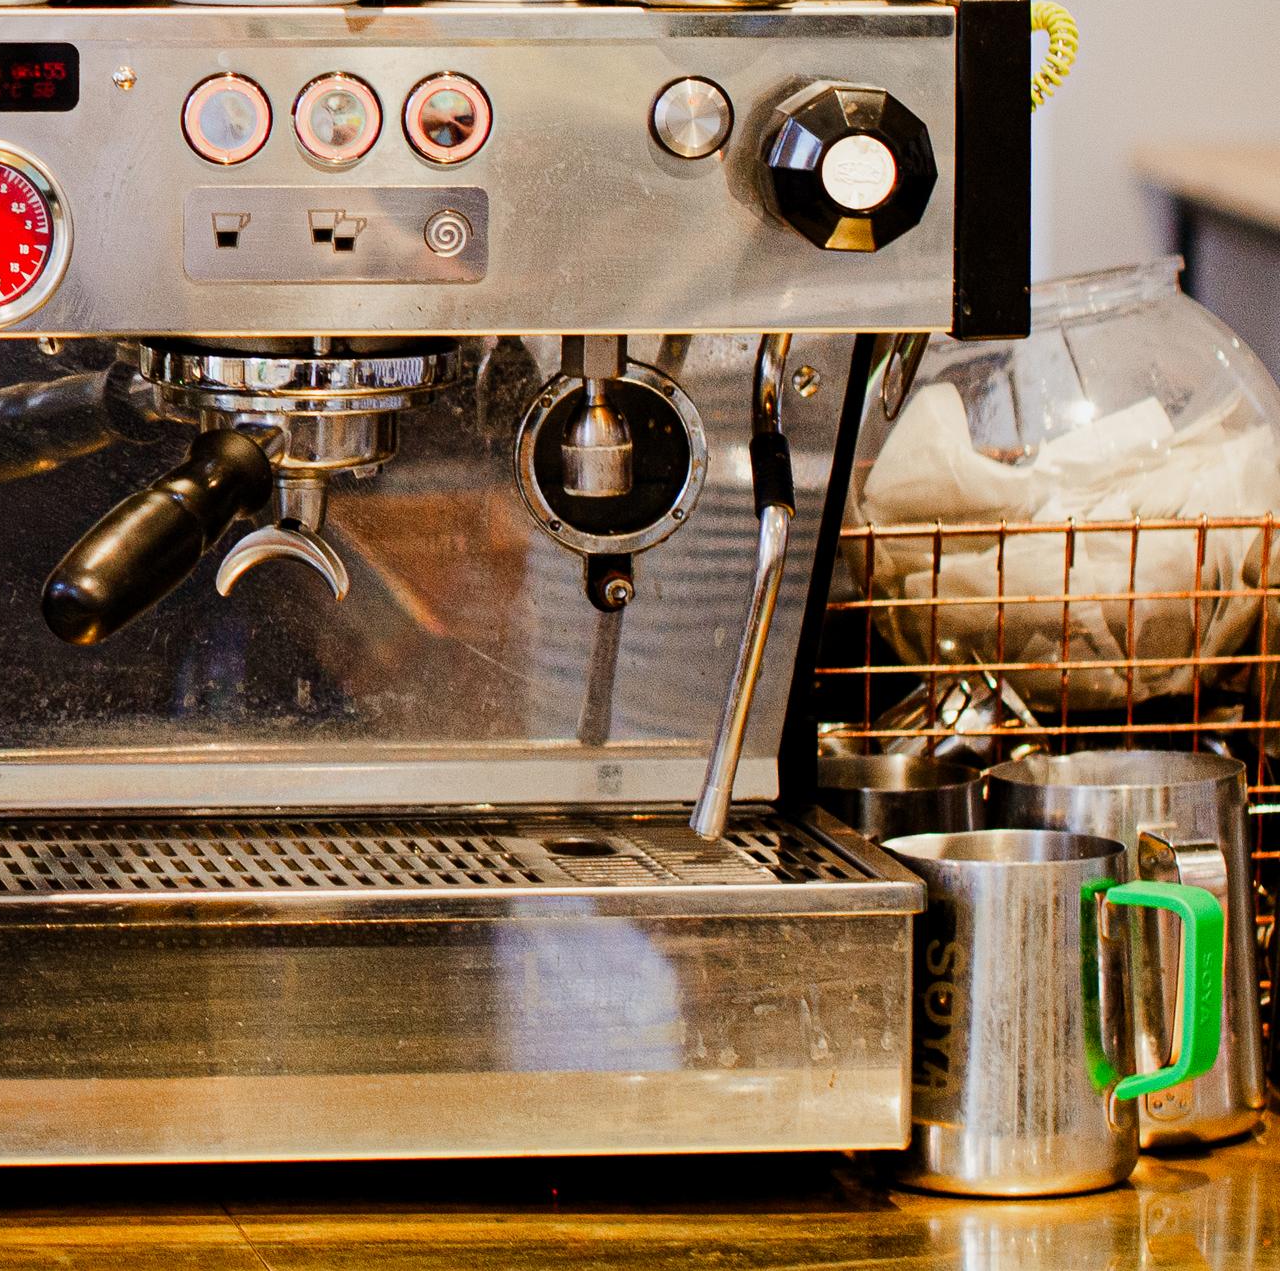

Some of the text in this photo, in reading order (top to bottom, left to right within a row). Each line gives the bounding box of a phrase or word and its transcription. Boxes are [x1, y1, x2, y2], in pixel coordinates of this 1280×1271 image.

[0, 183, 9, 194] 2
[24, 220, 33, 231] 3
[912, 938, 969, 1098] SOYA
